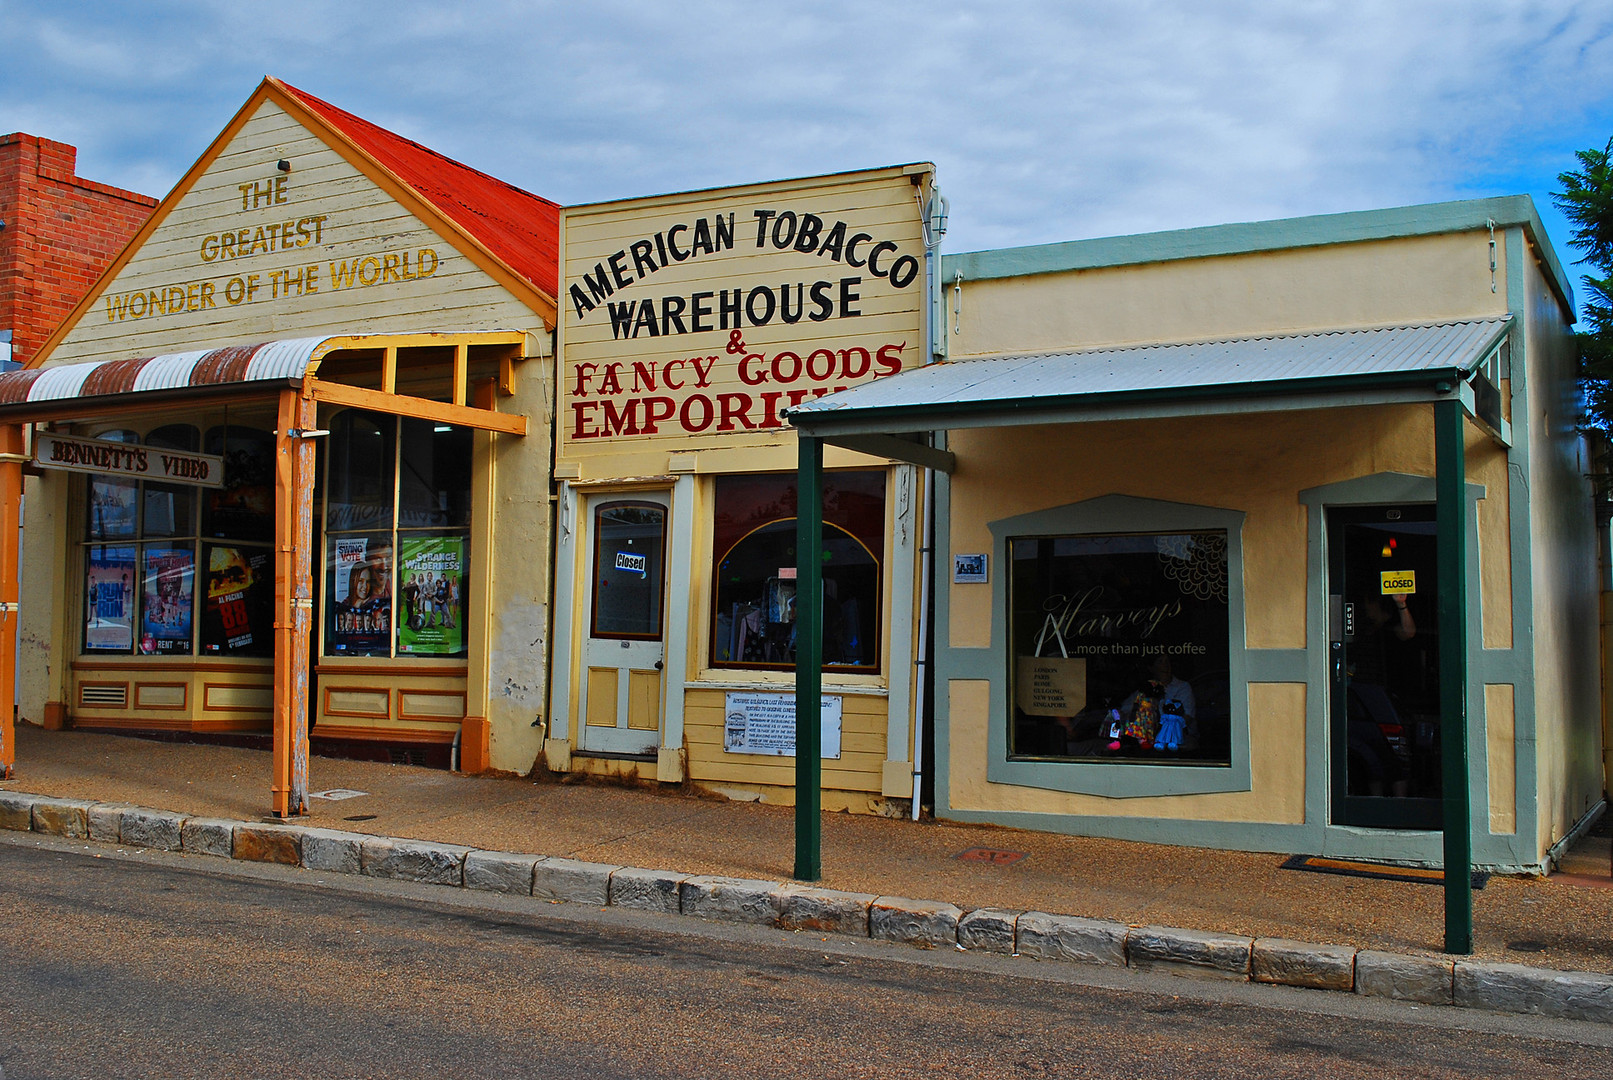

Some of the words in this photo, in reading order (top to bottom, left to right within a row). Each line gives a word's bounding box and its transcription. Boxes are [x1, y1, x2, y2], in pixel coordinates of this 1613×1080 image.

[239, 176, 288, 210] THE
[200, 215, 327, 262] GREATEST
[569, 212, 735, 320] AMERICAN
[753, 209, 919, 288] TOBACCO
[106, 282, 216, 322] WONDER
[225, 274, 260, 305] OF
[268, 265, 319, 298] THE
[330, 248, 439, 290] WORLD
[607, 276, 862, 340] WAREHOUSE
[726, 329, 747, 354] &
[572, 355, 719, 397] FANCY
[737, 341, 906, 386] GOODS
[571, 386, 848, 439] EMPORI
[50, 440, 148, 472] BENNETT'S
[160, 455, 209, 481] VIDEO
[338, 545, 363, 554] SWING
[341, 552, 361, 562] VOTE
[416, 552, 457, 562] STRANGE
[617, 554, 644, 570] Closed
[405, 560, 460, 571] WILDERNESS
[97, 582, 124, 600] RUN
[1383, 579, 1413, 589] CLOSED
[97, 601, 124, 618] RUN
[219, 599, 249, 629] 88
[1033, 585, 1182, 645] Harveys
[157, 640, 173, 649] RENT
[1112, 643, 1139, 654] than
[1142, 643, 1164, 657] just
[1167, 642, 1206, 654] coffee
